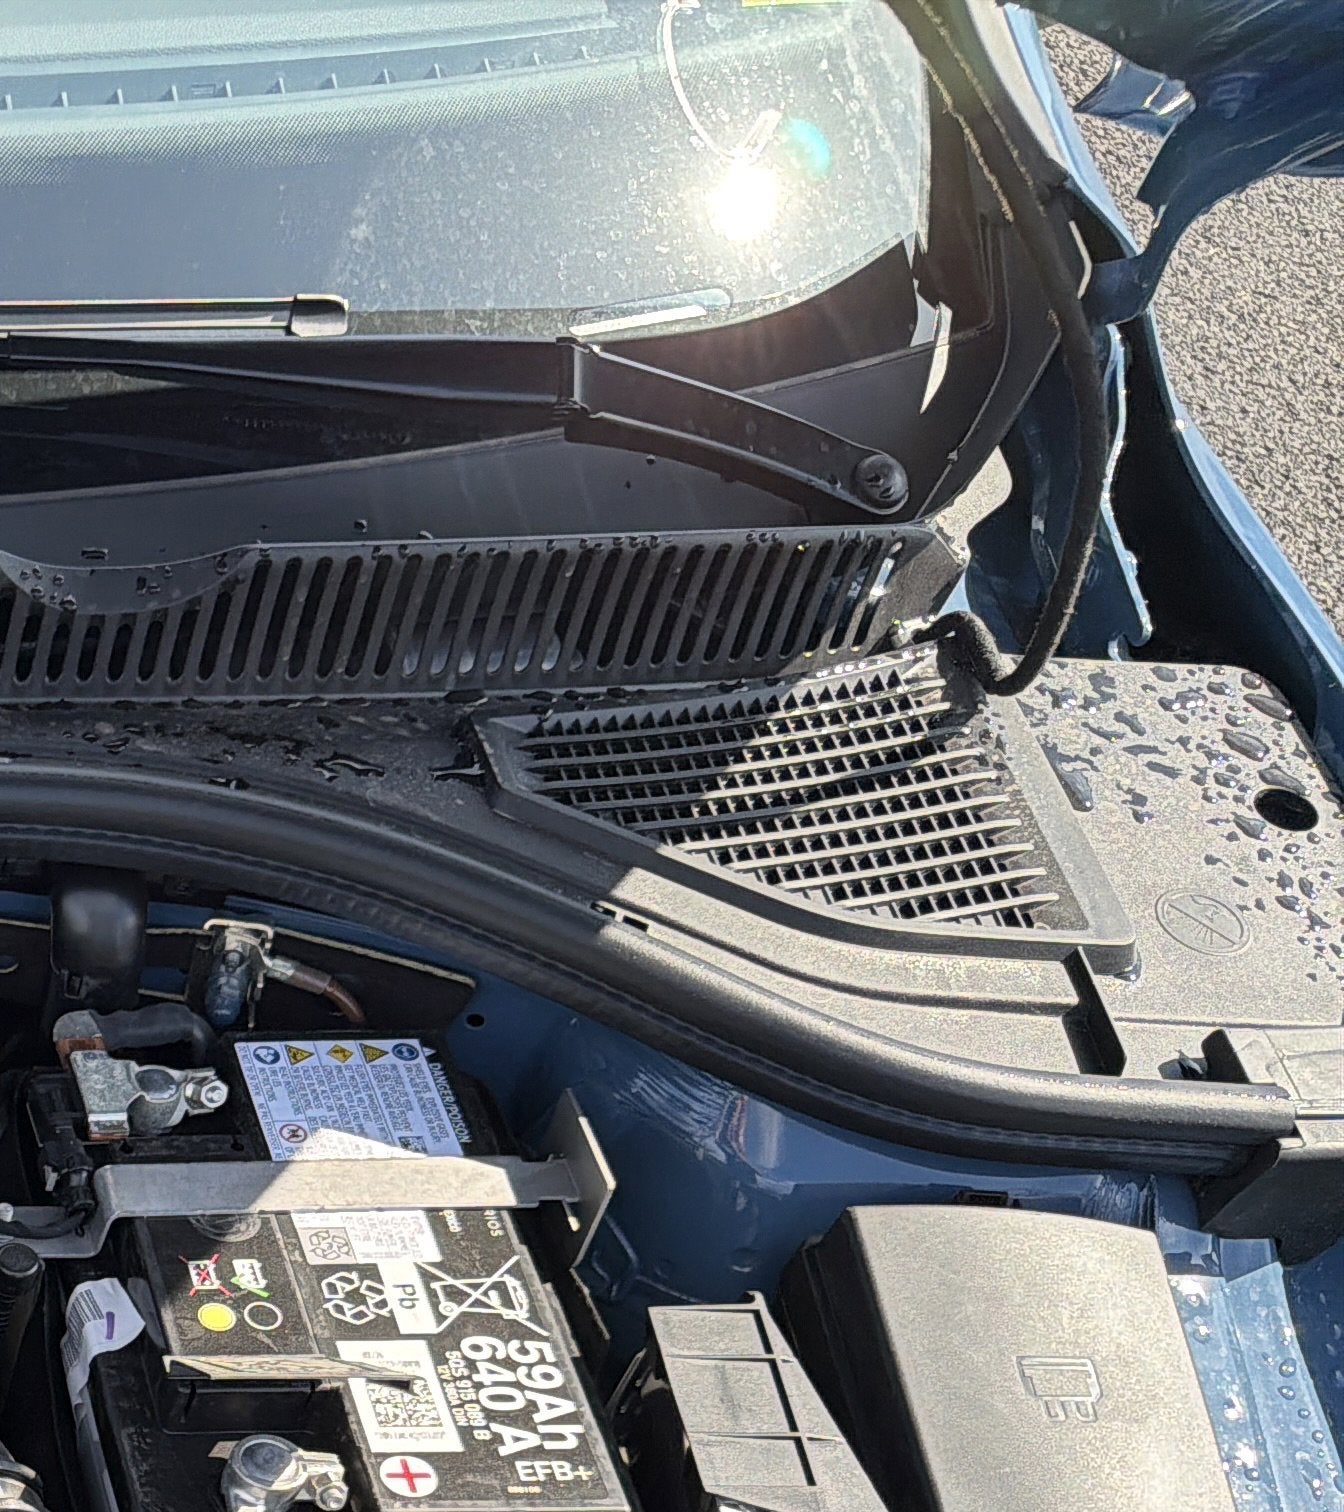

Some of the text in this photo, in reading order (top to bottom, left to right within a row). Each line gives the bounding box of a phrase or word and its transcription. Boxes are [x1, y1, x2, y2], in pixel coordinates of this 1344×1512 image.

[428, 1062, 472, 1144] DANGER/POISON
[392, 1284, 419, 1310] Pb
[460, 1335, 526, 1411] 640
[489, 1422, 542, 1457] A
[514, 1460, 593, 1482] EFB+
